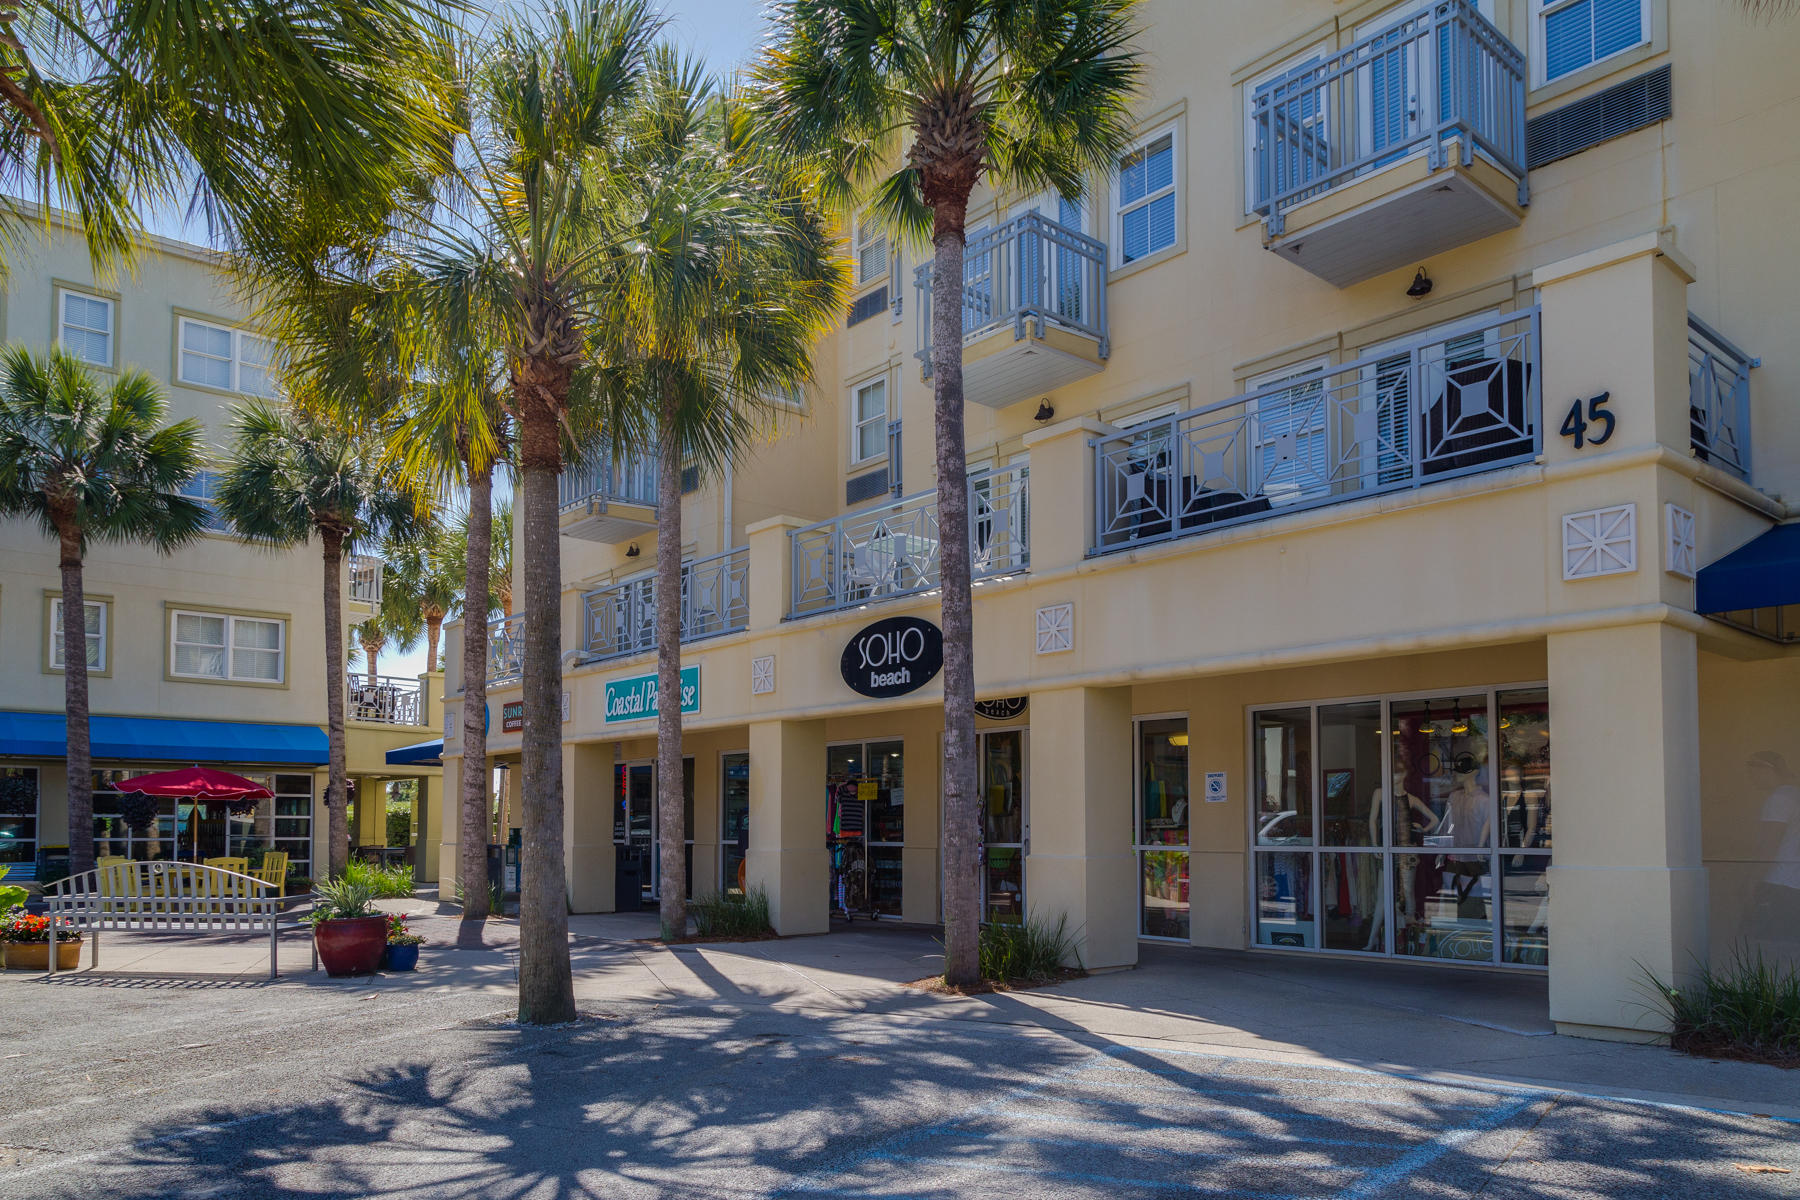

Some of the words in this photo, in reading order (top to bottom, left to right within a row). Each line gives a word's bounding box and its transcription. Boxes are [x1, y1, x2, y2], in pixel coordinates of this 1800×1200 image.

[1560, 391, 1616, 450] 45
[858, 627, 925, 670] SOHO
[870, 667, 911, 688] beach
[606, 680, 645, 717] Coastal
[646, 678, 696, 712] Paise
[506, 719, 522, 728] COFFEE
